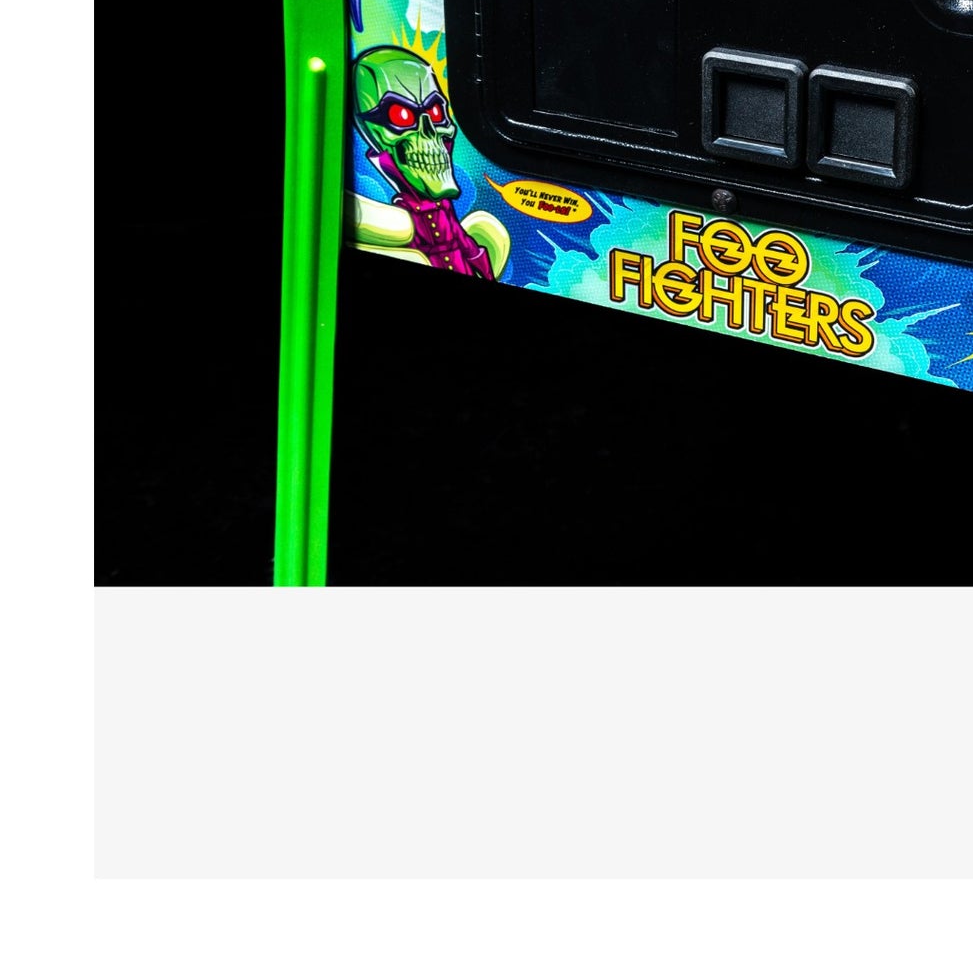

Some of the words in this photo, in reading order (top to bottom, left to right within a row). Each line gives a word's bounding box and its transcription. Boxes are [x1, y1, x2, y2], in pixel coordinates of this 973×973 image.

[514, 187, 538, 198] YOU'LL
[539, 192, 563, 203] NEVER
[521, 198, 536, 208] YOU
[669, 210, 810, 288] FOO
[609, 247, 875, 359] FIGHTERS
